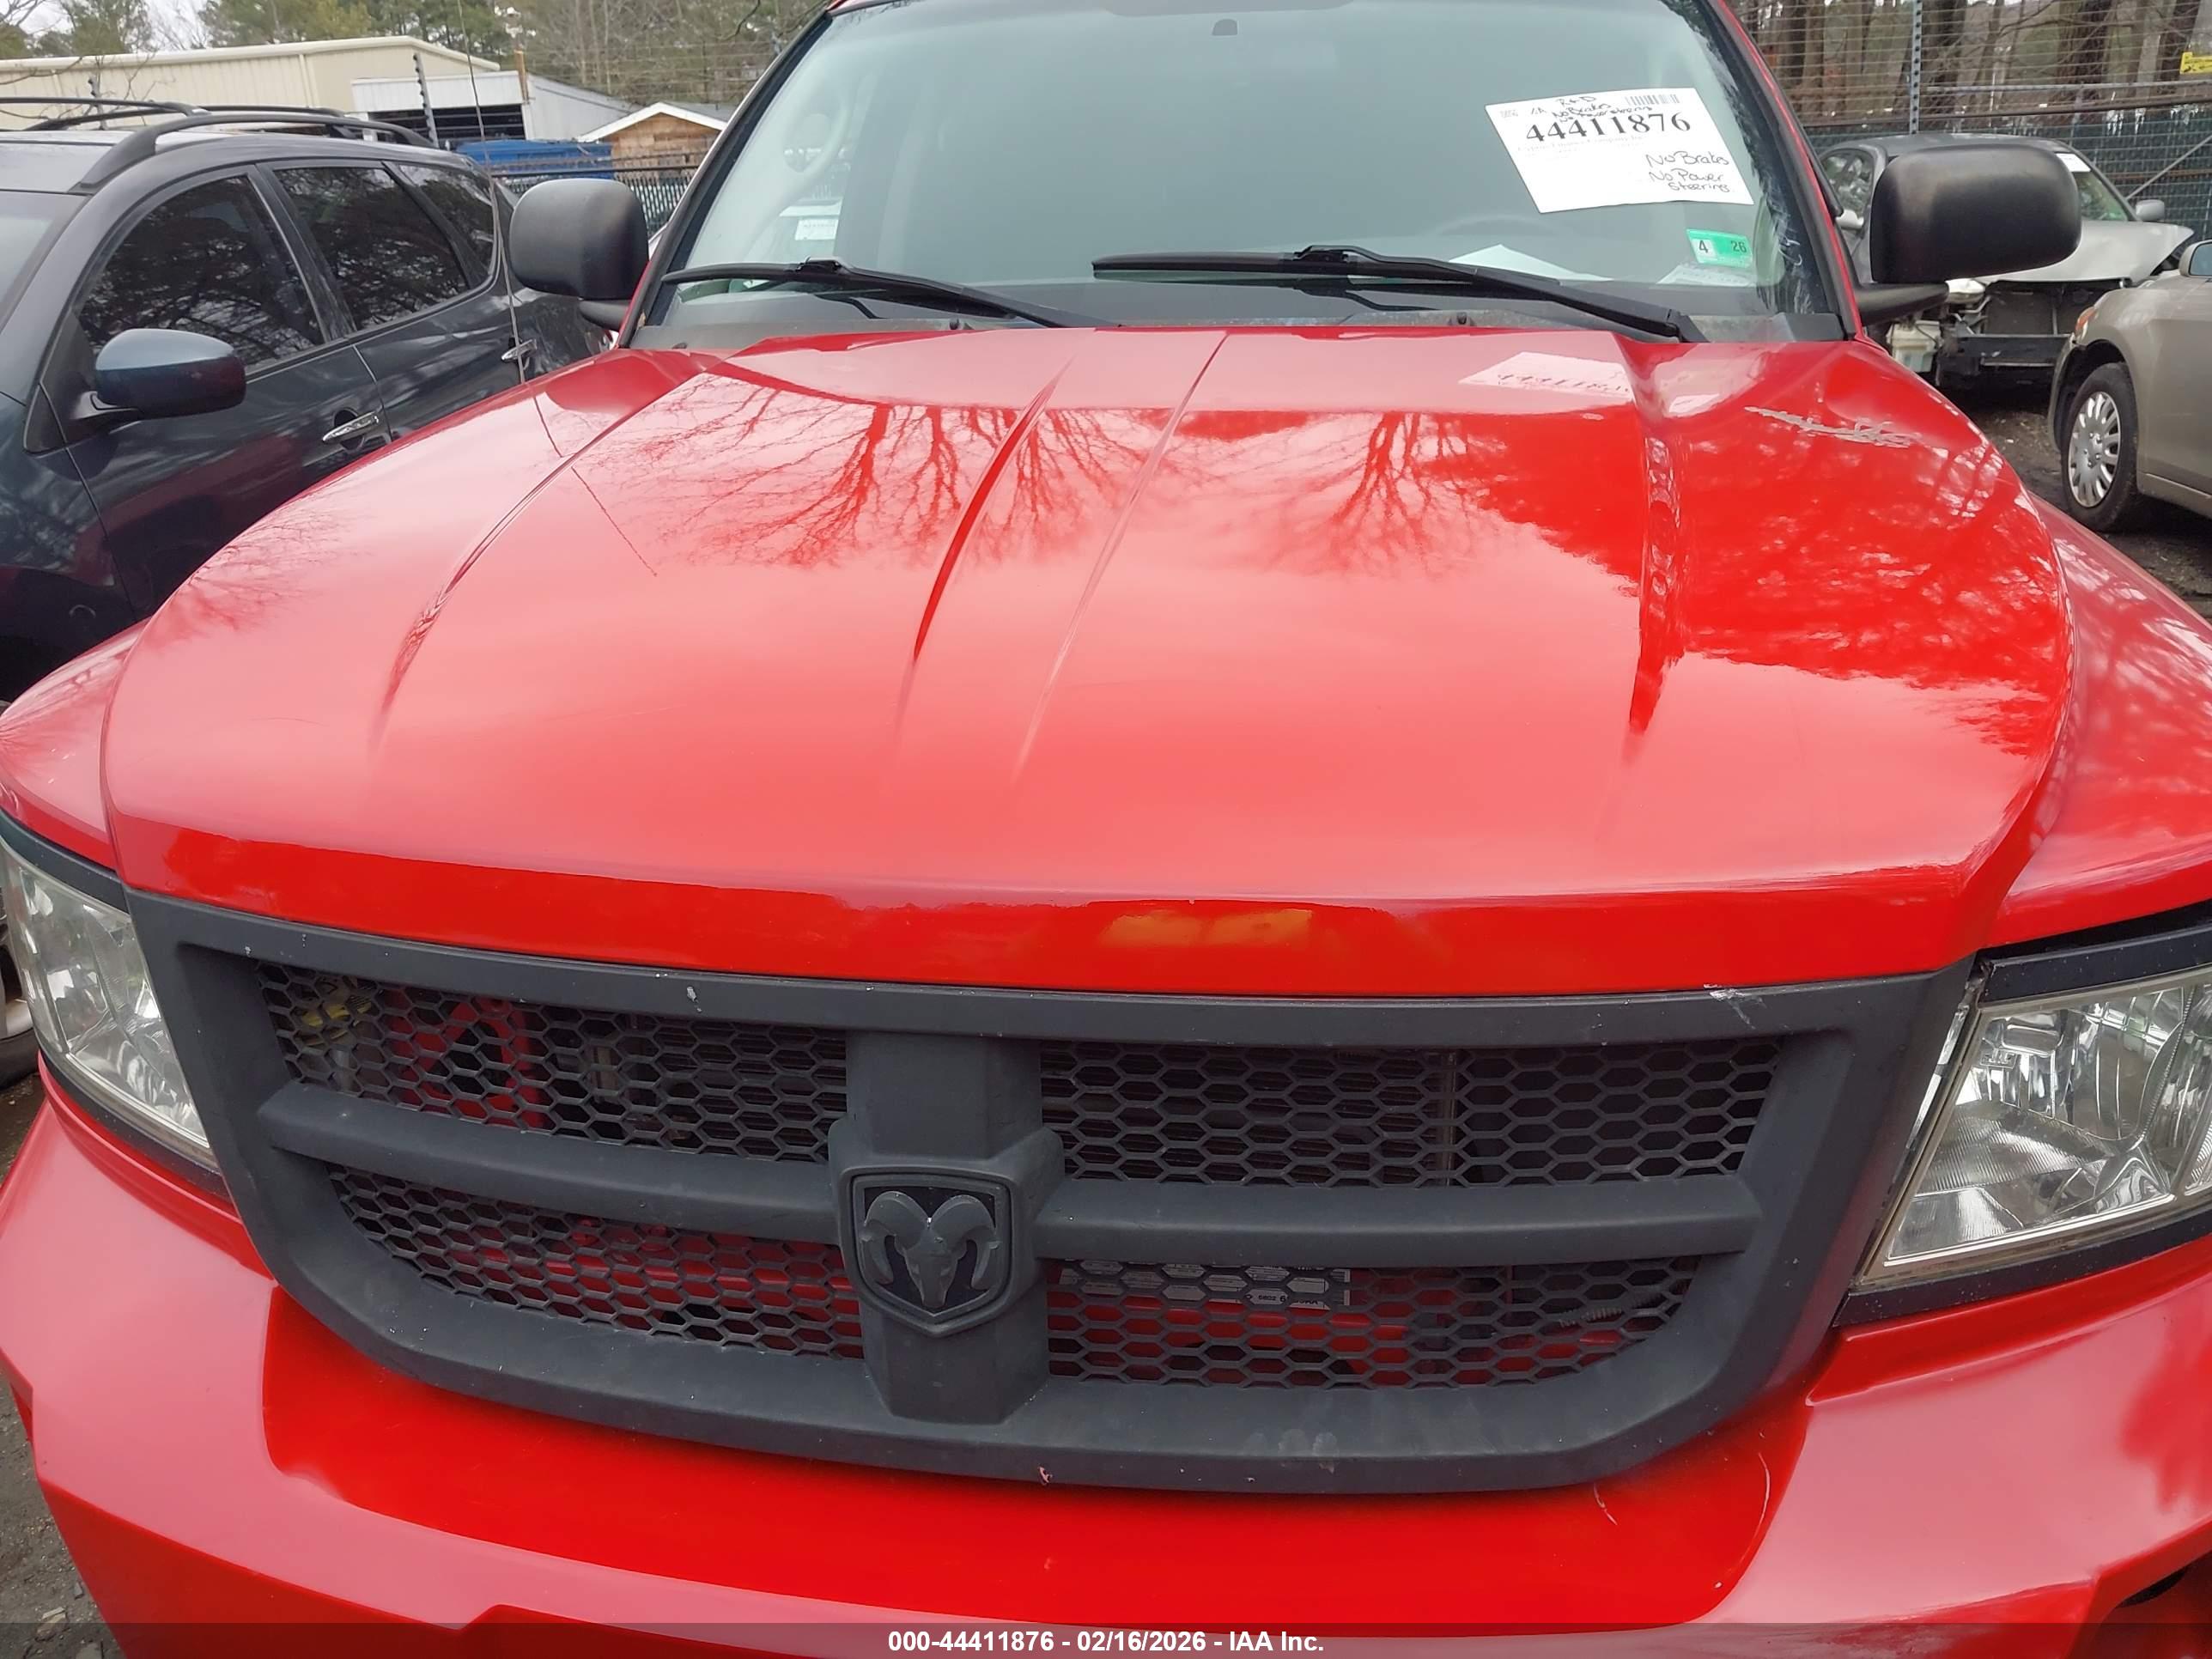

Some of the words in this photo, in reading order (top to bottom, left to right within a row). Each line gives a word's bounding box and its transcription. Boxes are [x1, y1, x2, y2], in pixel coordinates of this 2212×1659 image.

[1526, 112, 1691, 142] 44411876
[1645, 153, 1675, 168] No
[1674, 150, 1729, 166] Brakes
[1648, 171, 1674, 182] No
[1671, 167, 1723, 182] Power
[1698, 240, 1709, 253] 4
[1730, 240, 1747, 253] 26
